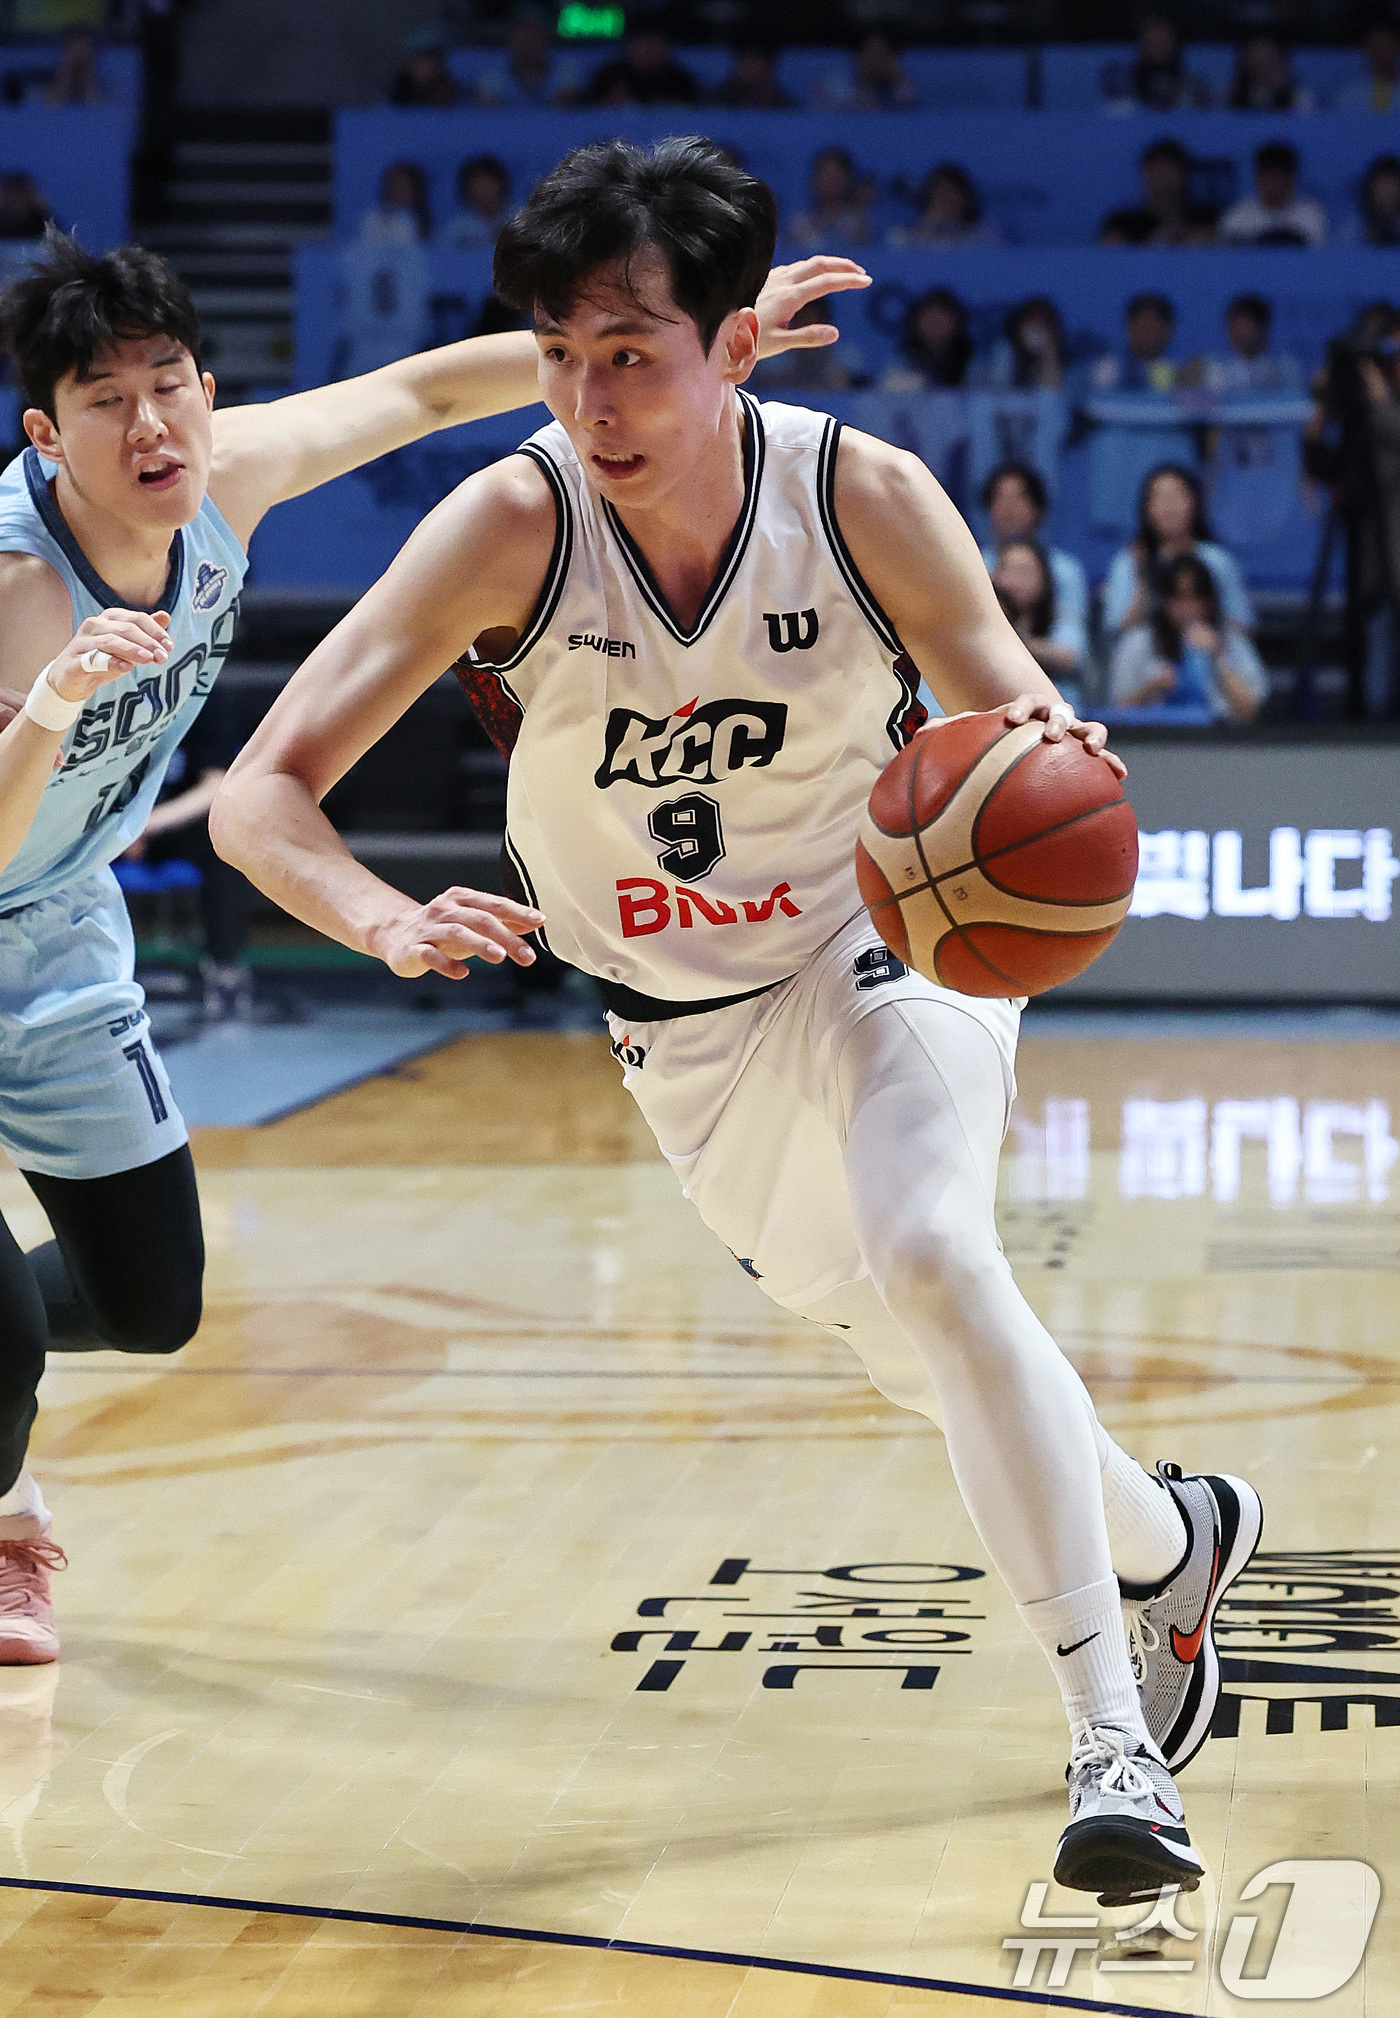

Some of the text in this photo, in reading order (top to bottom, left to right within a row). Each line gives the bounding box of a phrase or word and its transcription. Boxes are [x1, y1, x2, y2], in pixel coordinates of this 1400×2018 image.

[600, 702, 784, 787] KCC
[647, 791, 727, 884] 9
[853, 947, 909, 991] 9
[610, 1558, 987, 1692] 오션월드
